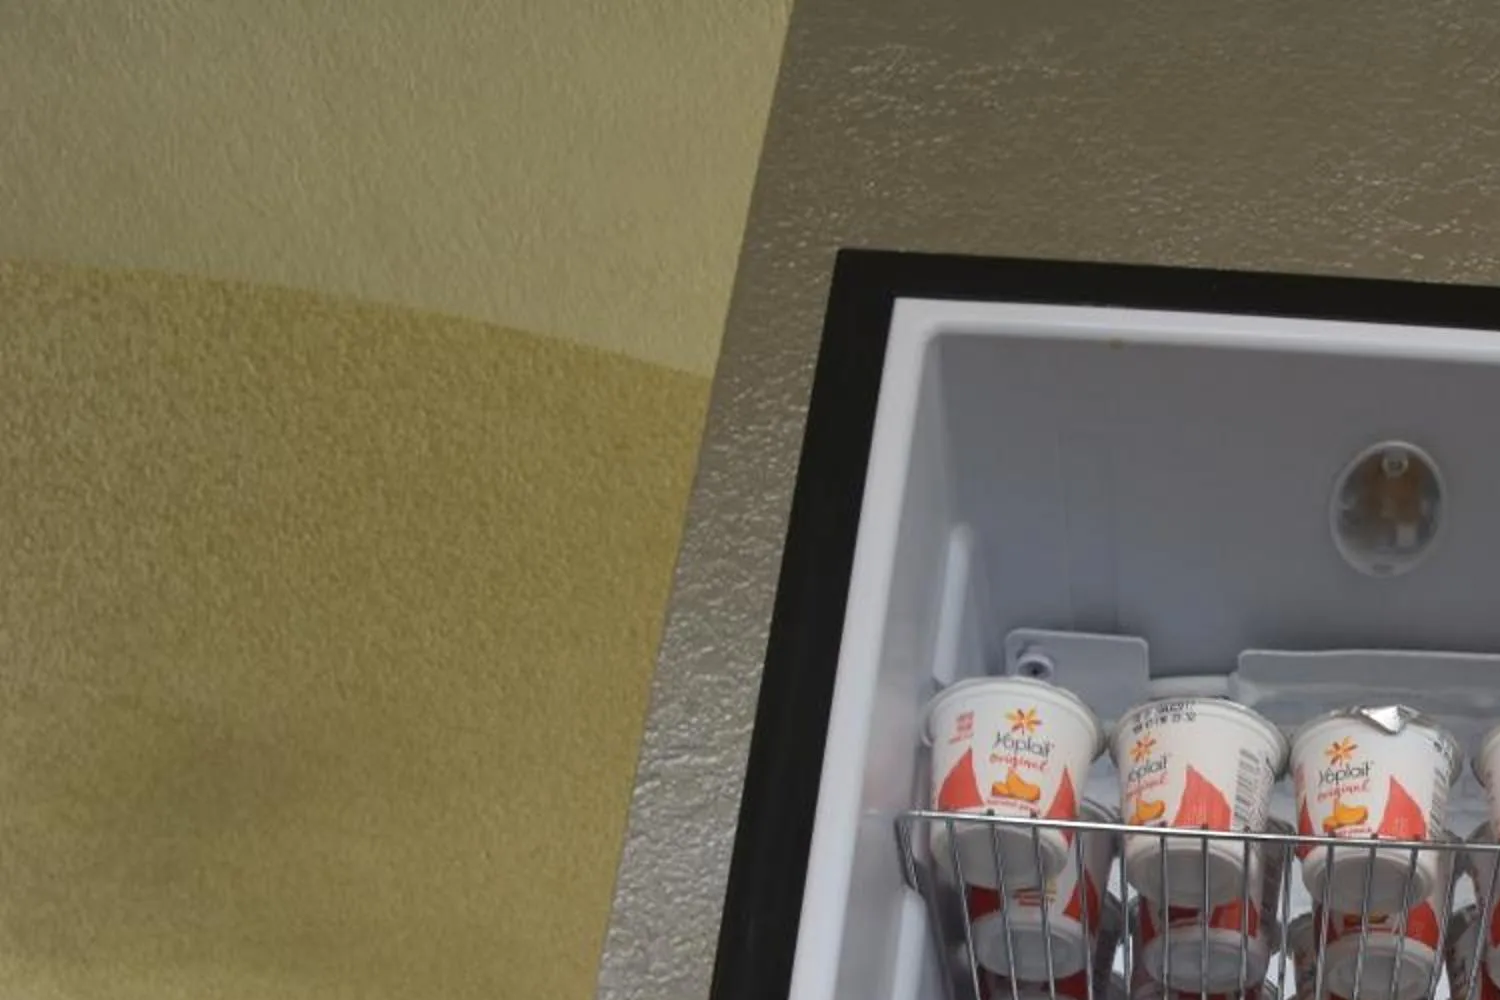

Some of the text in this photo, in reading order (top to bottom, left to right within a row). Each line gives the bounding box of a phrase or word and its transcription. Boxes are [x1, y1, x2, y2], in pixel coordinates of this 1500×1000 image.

[993, 731, 1052, 759] Yoplait
[1128, 755, 1168, 784] oplait
[1318, 761, 1370, 787] Yoplait
